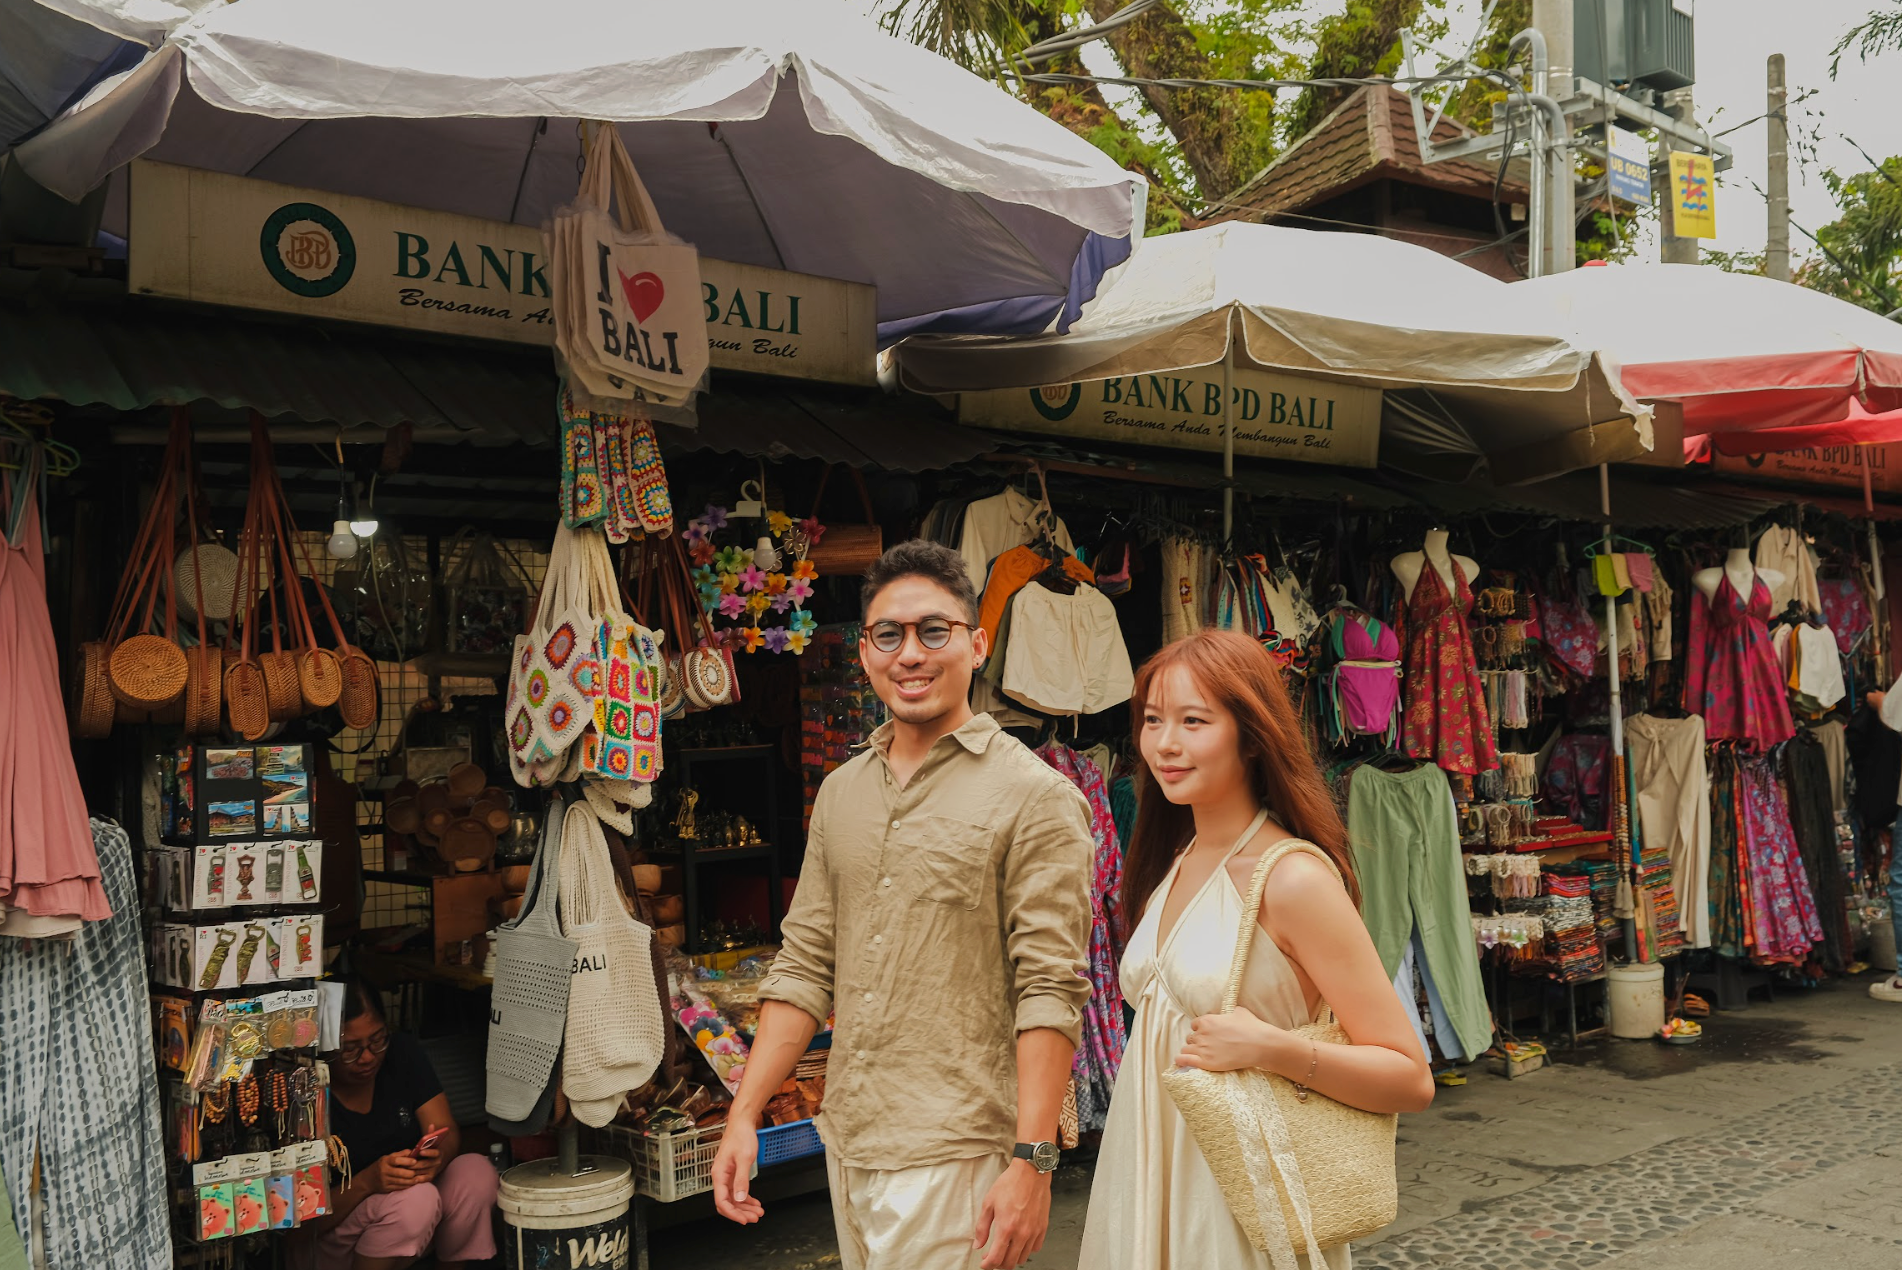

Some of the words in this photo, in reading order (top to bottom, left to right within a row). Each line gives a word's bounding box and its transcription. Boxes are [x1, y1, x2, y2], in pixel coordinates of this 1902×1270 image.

[1610, 156, 1624, 173] UB
[1625, 162, 1649, 181] 0652
[392, 231, 551, 298] BANK
[702, 281, 802, 336] BALI
[597, 239, 613, 306] I
[397, 288, 513, 320] Bersama
[752, 338, 798, 358] Bali
[598, 307, 683, 375] BALI
[1101, 375, 1194, 413] BANK
[1268, 391, 1335, 430] BALI
[1102, 410, 1166, 430] Bersama
[1171, 419, 1211, 436] Anda
[1303, 434, 1331, 449] Bali
[1822, 445, 1850, 465] BPD
[571, 953, 607, 974] BALI
